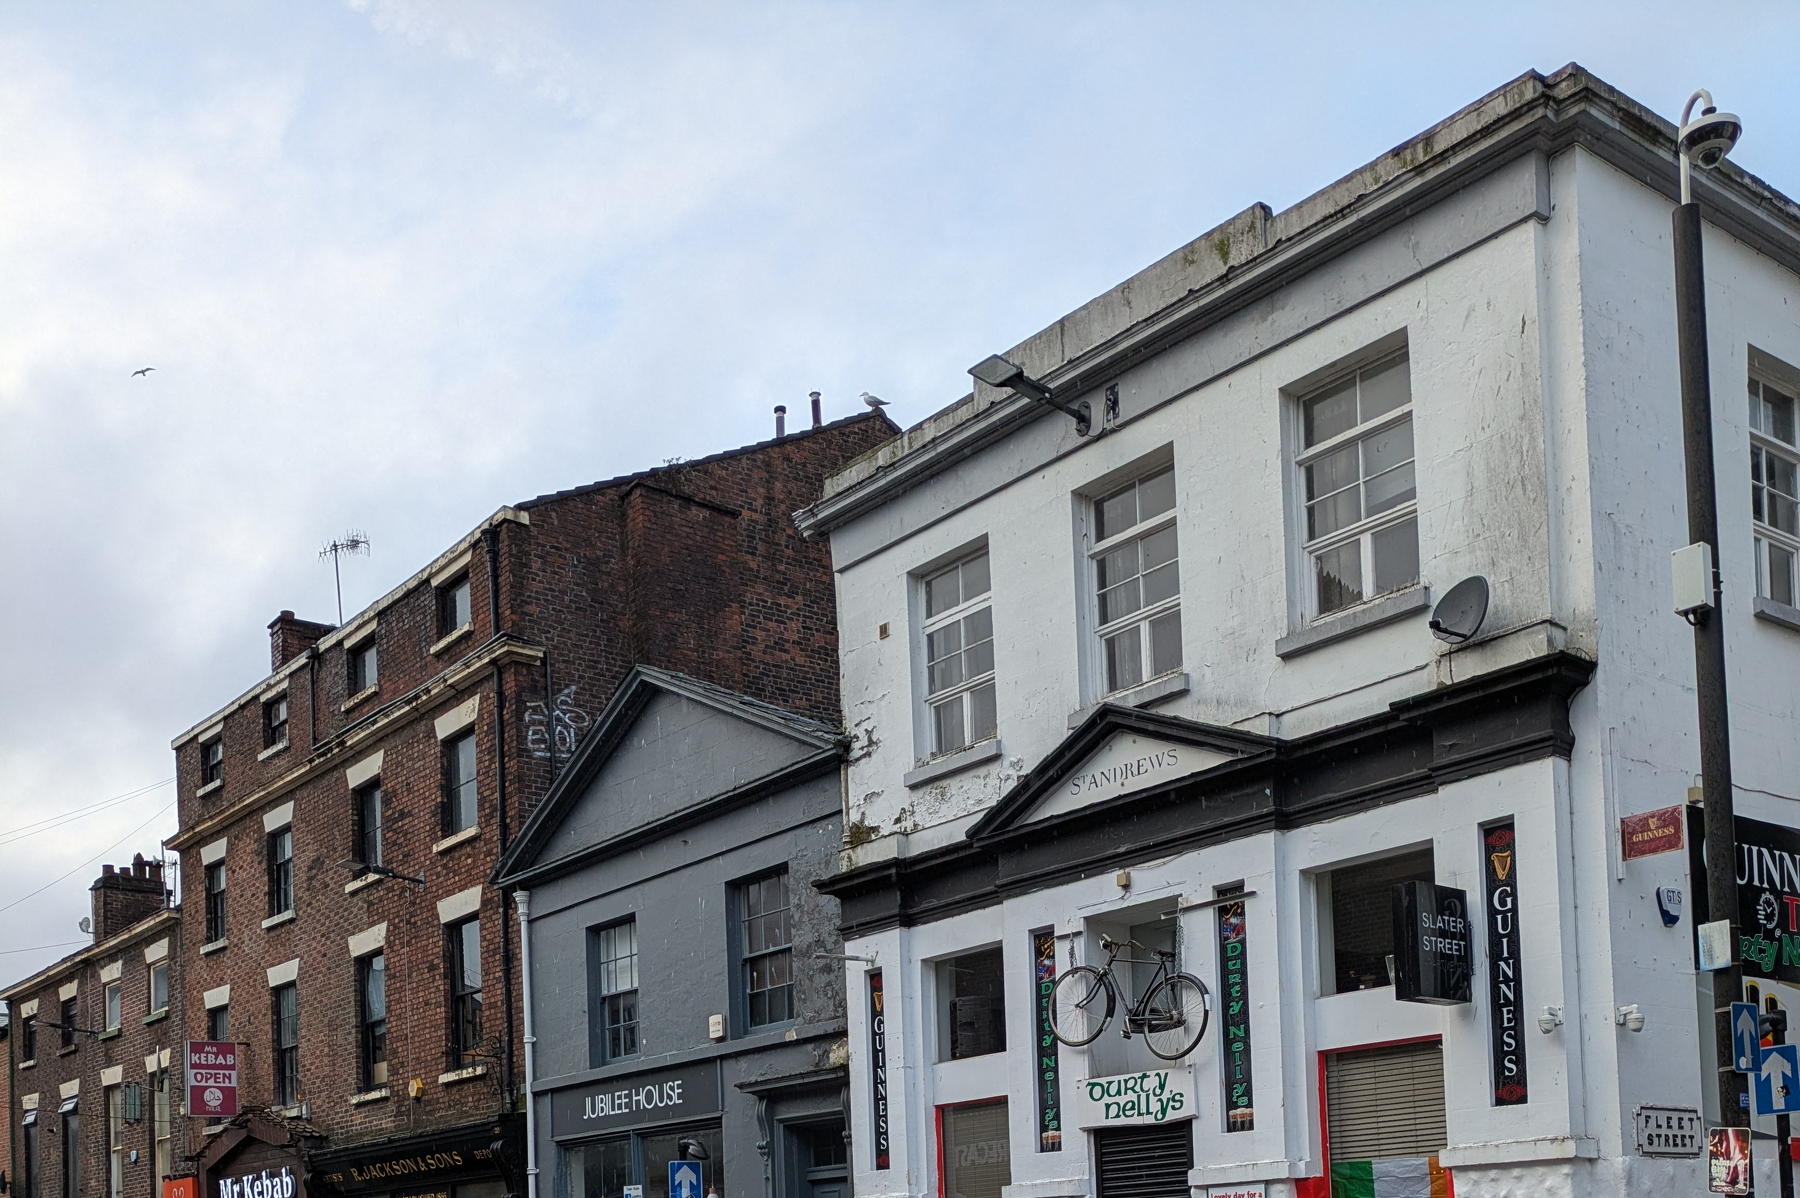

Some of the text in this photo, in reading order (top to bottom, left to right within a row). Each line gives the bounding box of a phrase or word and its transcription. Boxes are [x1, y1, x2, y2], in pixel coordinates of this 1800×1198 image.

[1632, 825, 1675, 843] GUINNESS
[1422, 912, 1465, 934] SLATER
[1422, 935, 1466, 956] STREET
[1493, 886, 1517, 1077] GUINNESS
[191, 1053, 235, 1065] KEBAB
[193, 1071, 232, 1085] OPEN
[874, 1016, 888, 1150] GUINNESS
[583, 1080, 683, 1120] JUBILEE HOUSE
[1644, 1114, 1695, 1131] FLEET
[1647, 1133, 1695, 1148] STREET
[428, 1150, 463, 1170] SONS
[1247, 1190, 1256, 1198] for
